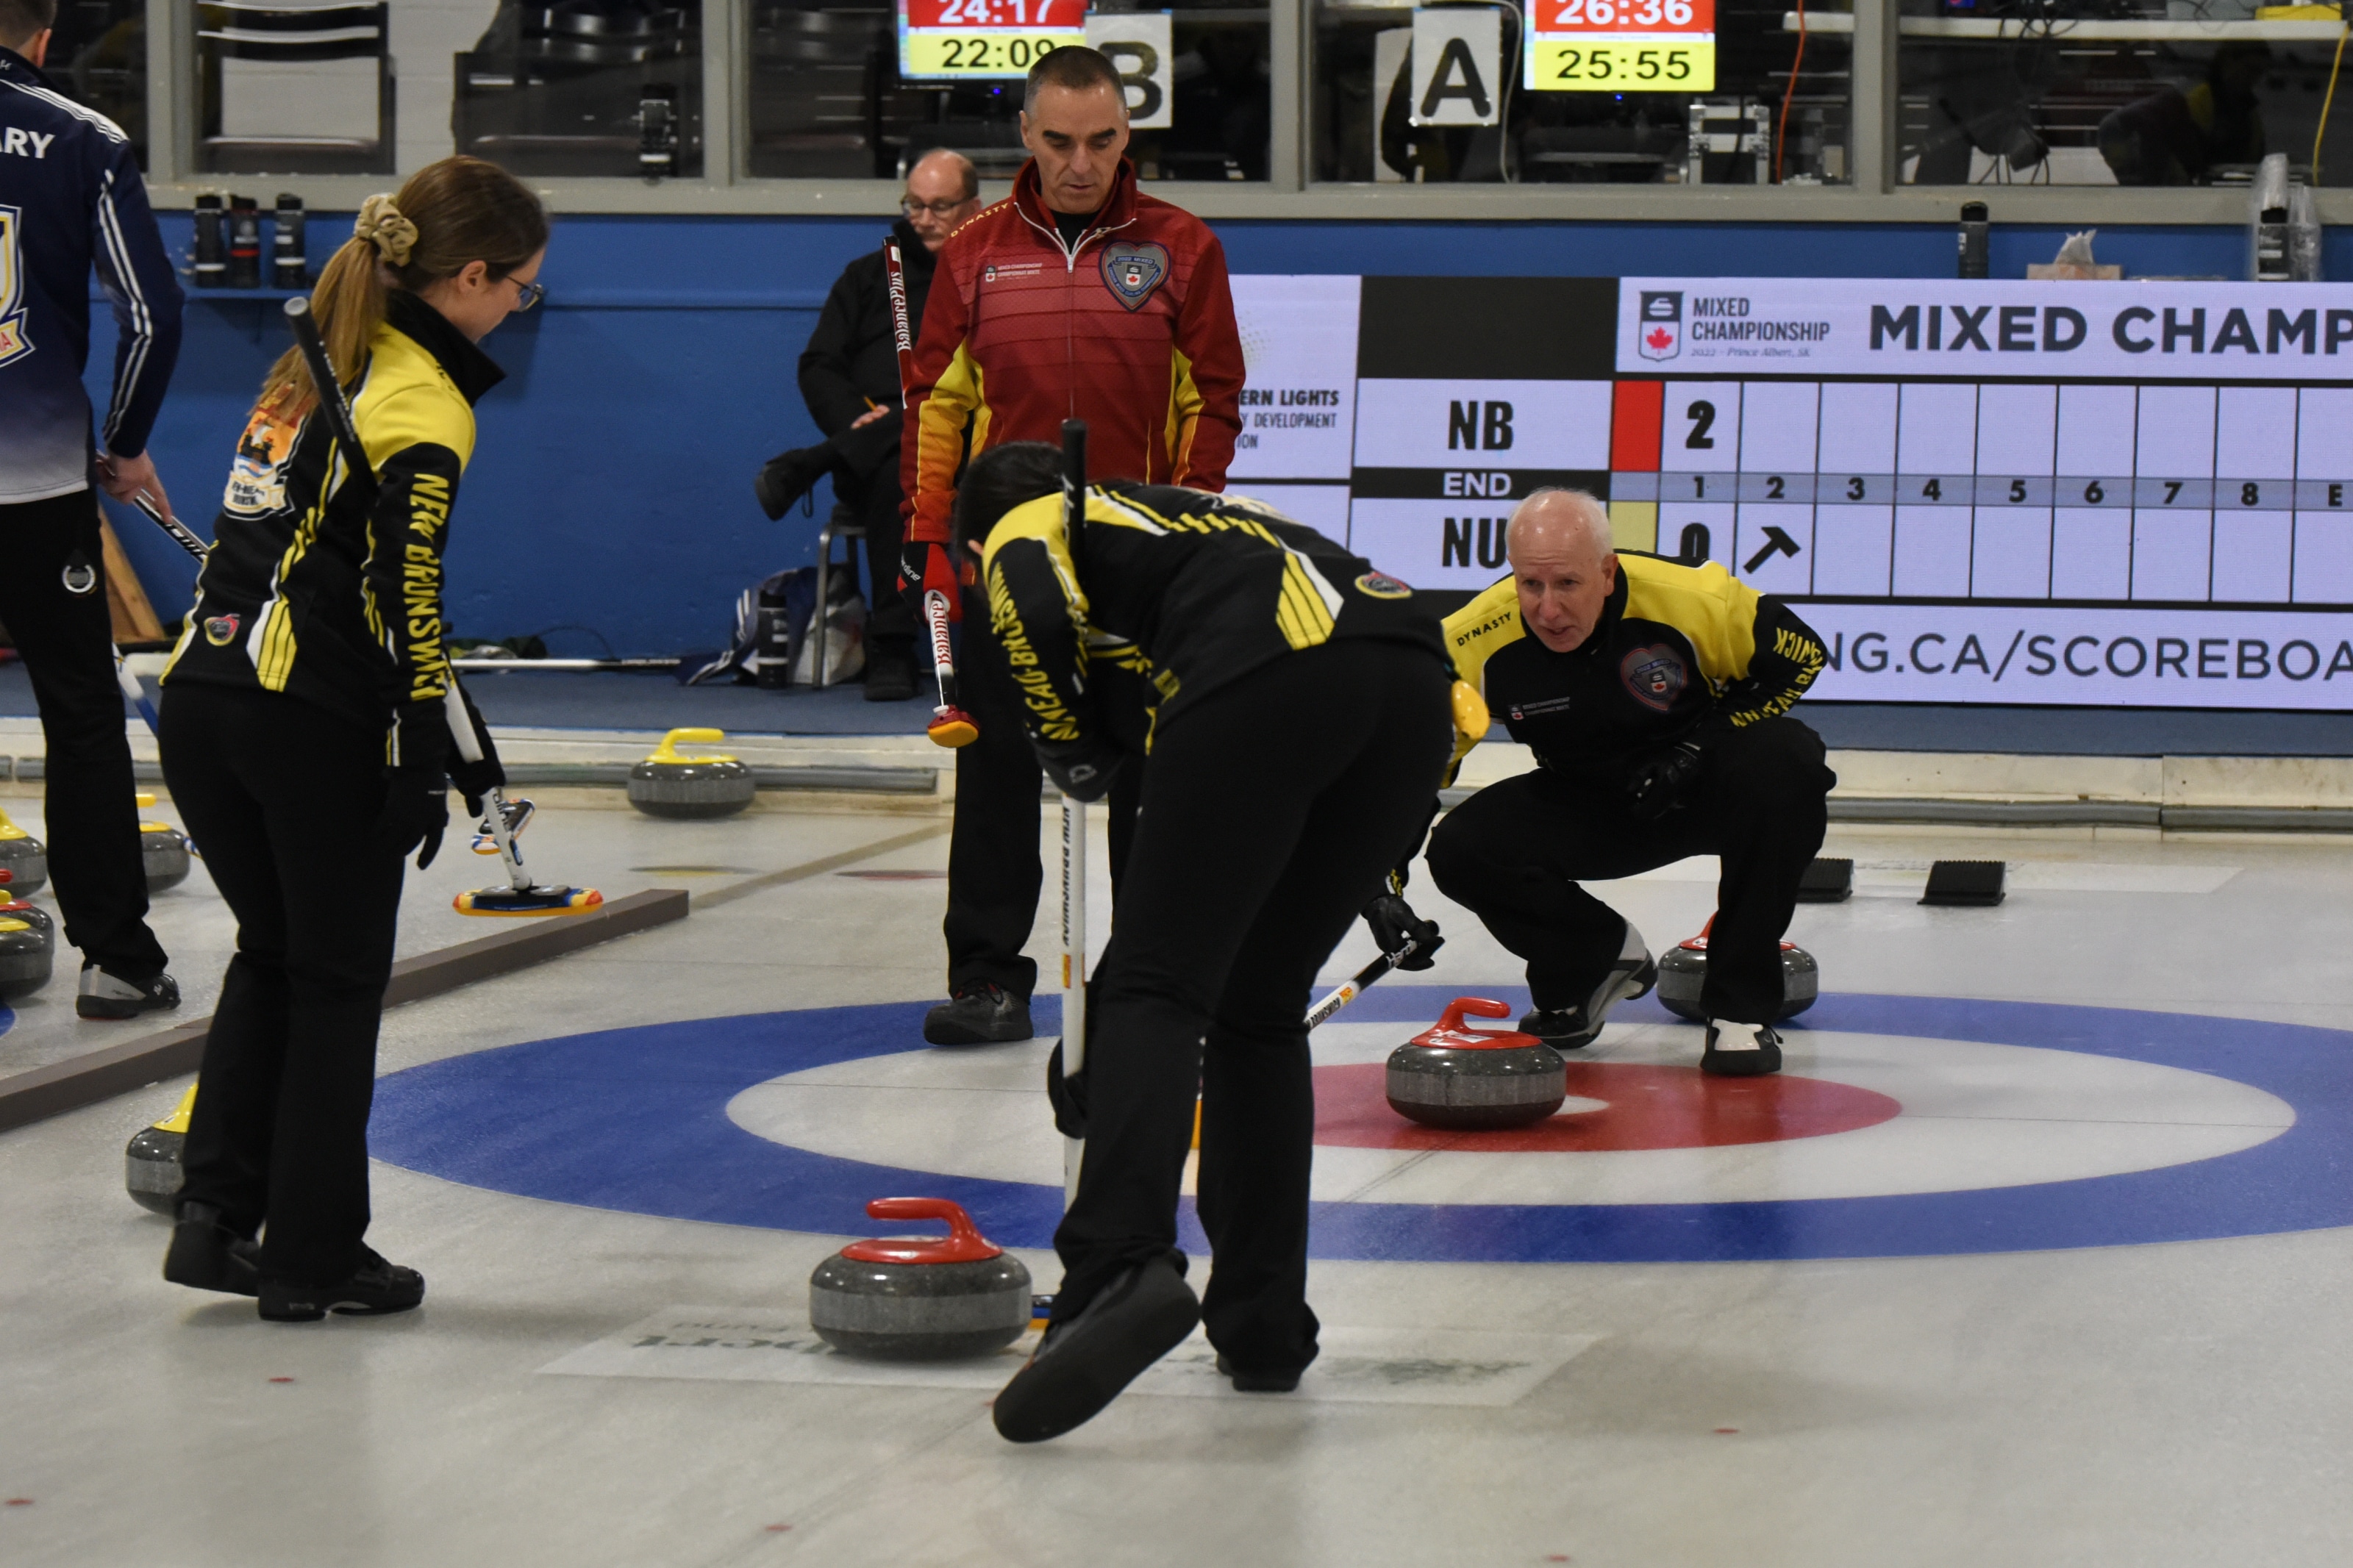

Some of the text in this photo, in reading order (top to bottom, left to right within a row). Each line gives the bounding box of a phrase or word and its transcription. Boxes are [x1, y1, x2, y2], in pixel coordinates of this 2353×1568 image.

[938, 0, 1054, 24] 24:17
[1555, 0, 1693, 25] 26:36
[942, 39, 1056, 68] 22:09
[1556, 49, 1690, 79] 25:55
[1099, 41, 1162, 121] B
[1421, 37, 1492, 118] A
[951, 203, 1008, 237] DYNASTY
[889, 271, 912, 352] BalancePlus
[1693, 297, 1749, 317] MIXED
[1692, 321, 1830, 341] CHAMPIONSHIP
[1870, 305, 2353, 355] MIXED CHAMP
[1280, 390, 1339, 406] LIGHTS
[1254, 412, 1336, 428] DEVELOPMENT
[1449, 401, 1513, 451] NB
[1685, 401, 1716, 449] 2
[1443, 473, 2343, 506] END 1 2 3 4 5 6 7 8 E
[410, 473, 449, 543] NEW
[1442, 518, 1507, 569] NU
[1456, 612, 1512, 647] DYNASTY
